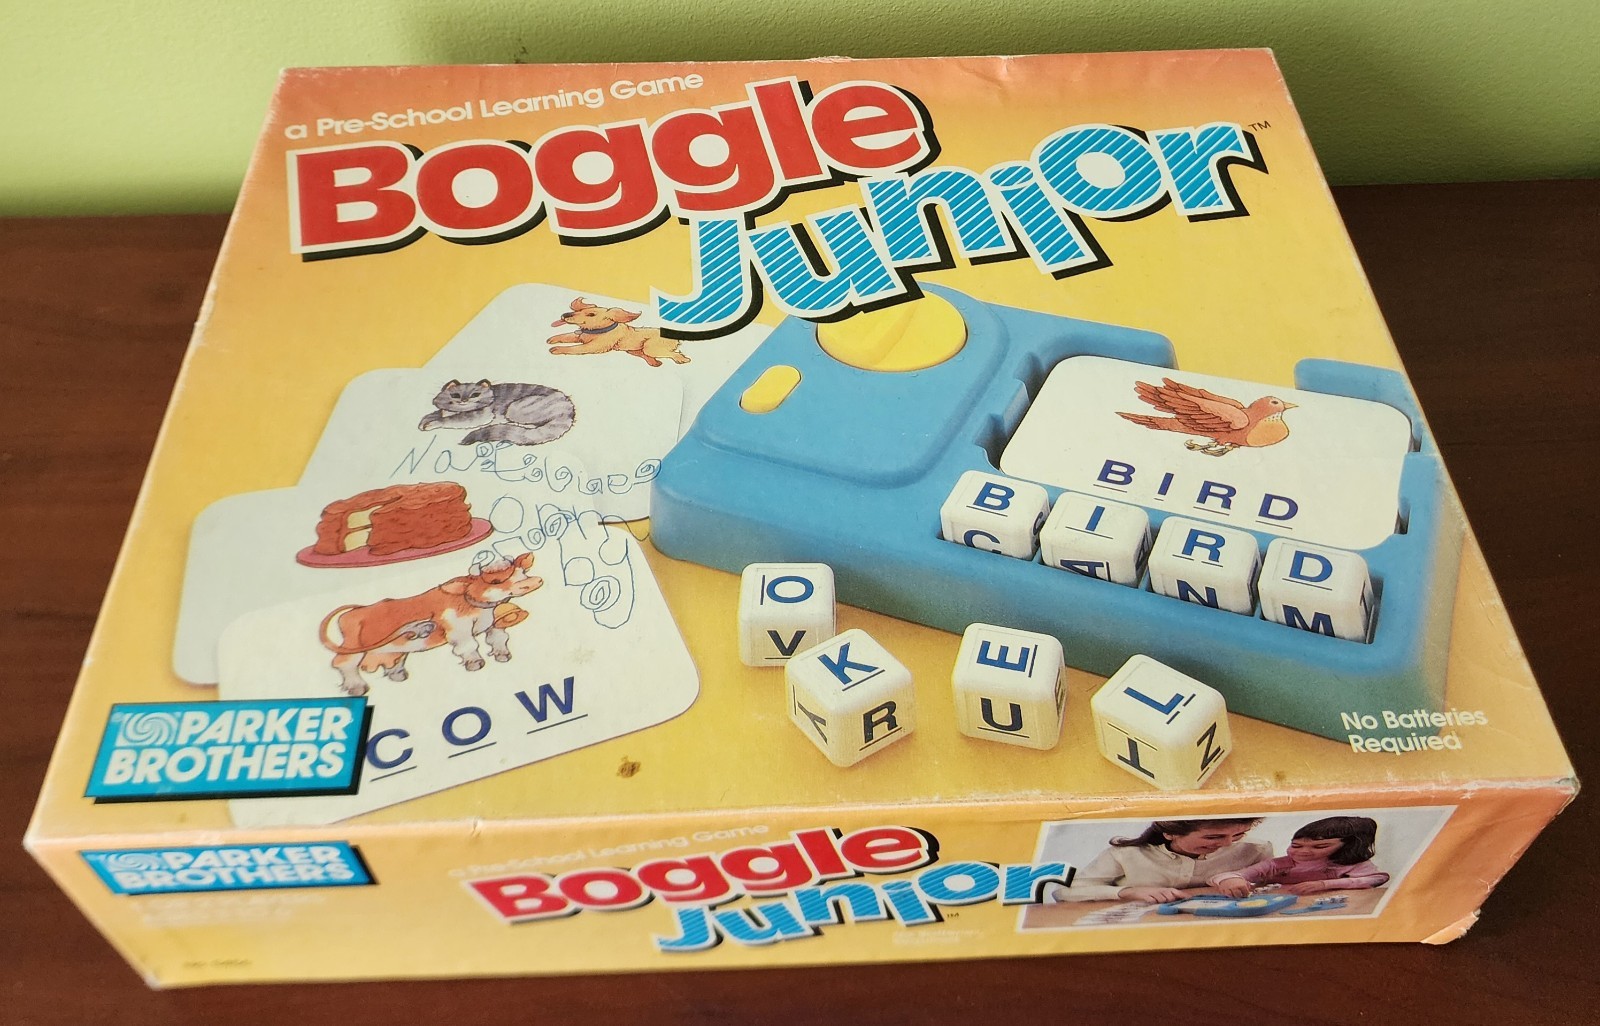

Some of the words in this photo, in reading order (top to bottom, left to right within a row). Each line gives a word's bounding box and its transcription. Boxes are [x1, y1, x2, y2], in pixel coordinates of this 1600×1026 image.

[284, 124, 308, 140] a
[317, 107, 473, 137] Pre-School
[480, 86, 604, 119] Learning
[609, 72, 704, 101] Game
[288, 77, 926, 254] Boggle
[651, 121, 1249, 331] Junior
[767, 629, 807, 656] V
[976, 639, 1030, 673] E
[817, 642, 879, 685] K
[980, 697, 1024, 732] U
[1123, 686, 1185, 716] L
[1340, 711, 1379, 731] No
[1382, 708, 1489, 730] Batteries
[175, 707, 353, 746] PARKER
[863, 700, 899, 743] R
[1348, 731, 1463, 755] Required
[103, 742, 347, 786] BROTHERS
[160, 845, 345, 870] PARKER
[591, 834, 689, 860] Learning
[692, 823, 770, 843] Game
[113, 863, 355, 890] BROTHERS
[470, 826, 925, 924] Boggle
[659, 862, 1071, 952] Junior
